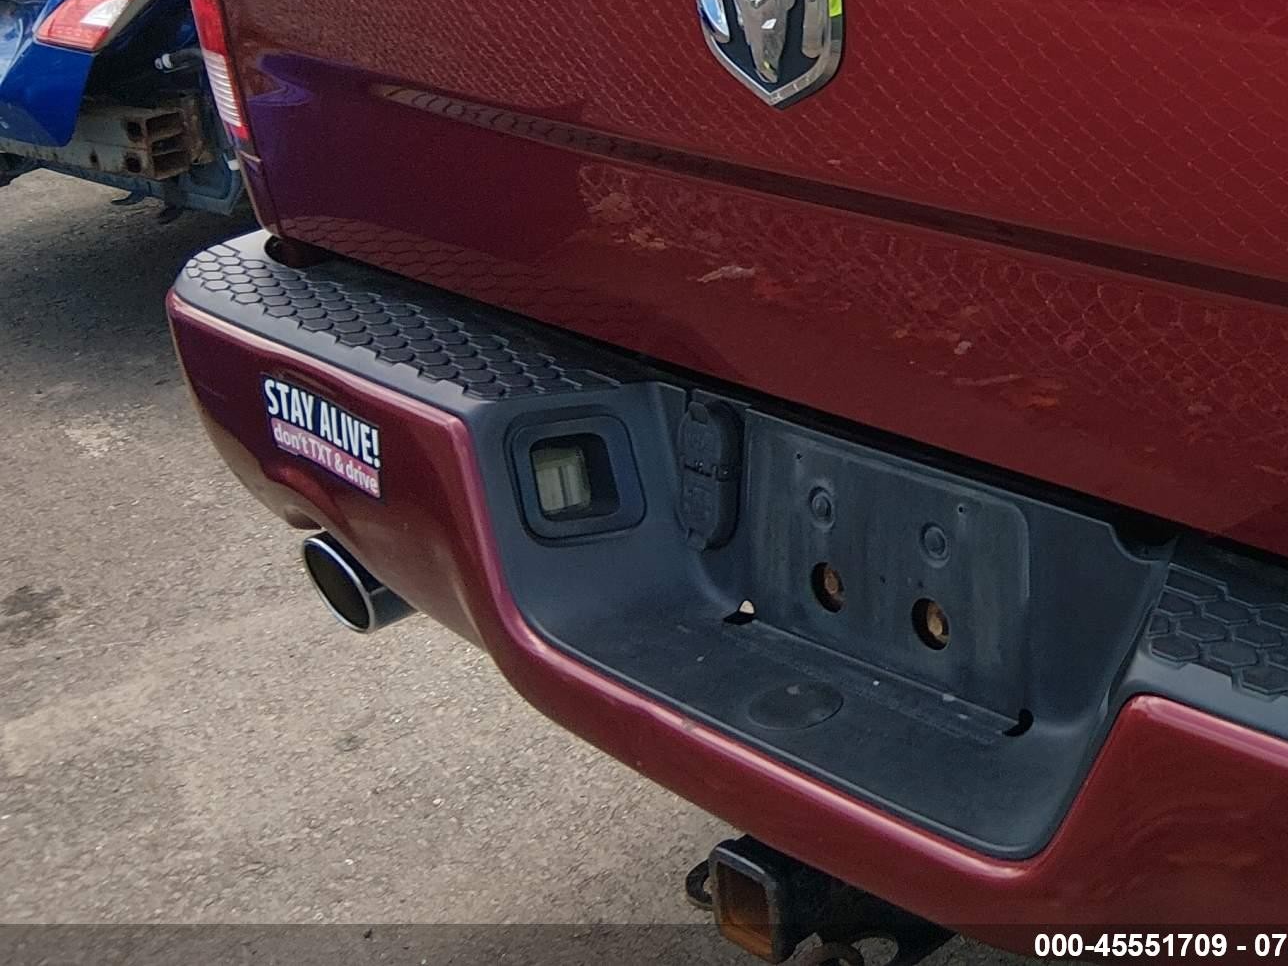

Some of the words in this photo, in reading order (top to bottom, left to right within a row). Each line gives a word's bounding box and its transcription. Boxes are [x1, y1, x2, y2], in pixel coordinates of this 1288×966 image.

[264, 379, 315, 431] STAY
[319, 400, 381, 468] ALIVE!
[273, 423, 309, 454] don't
[307, 439, 332, 467] TXT
[334, 452, 345, 475] &
[345, 460, 380, 494] drive
